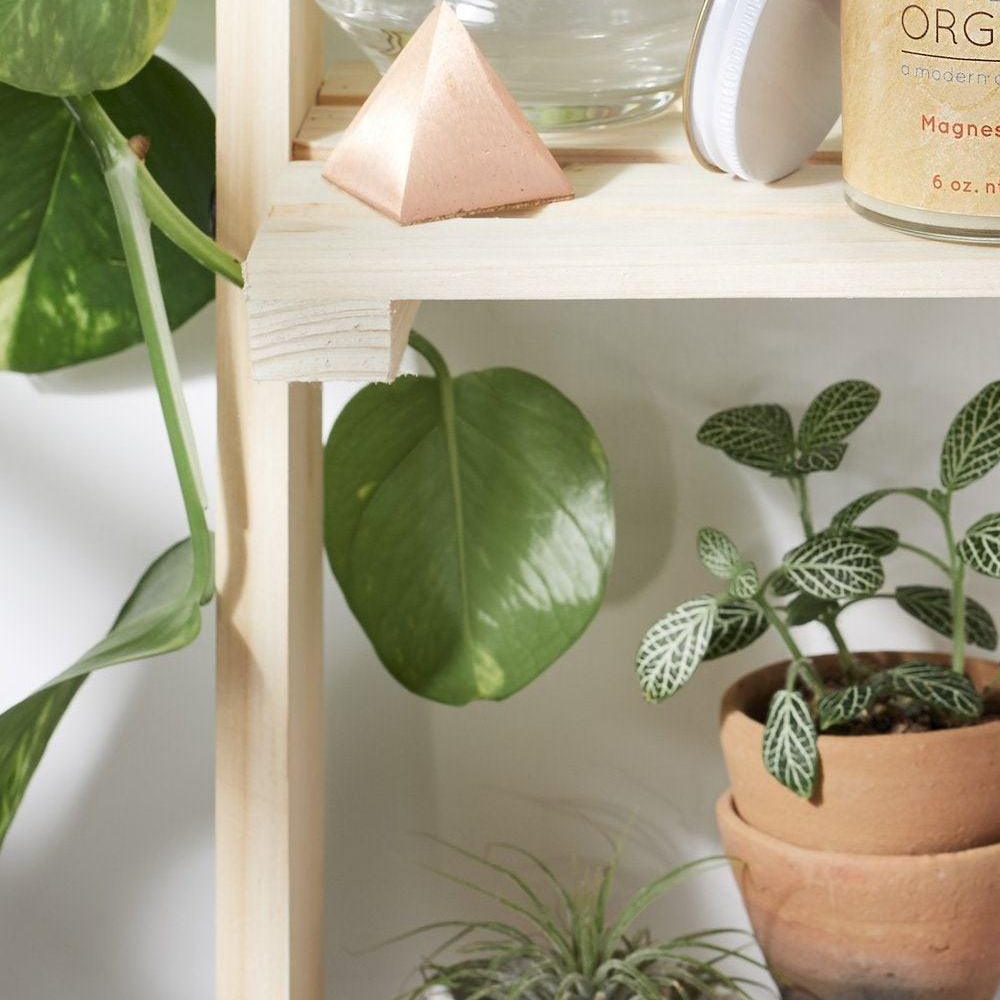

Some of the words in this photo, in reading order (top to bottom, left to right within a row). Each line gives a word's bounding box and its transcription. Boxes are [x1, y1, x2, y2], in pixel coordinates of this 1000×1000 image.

[901, 64, 910, 76] a
[932, 174, 942, 189] 6
[951, 178, 978, 193] oz.
